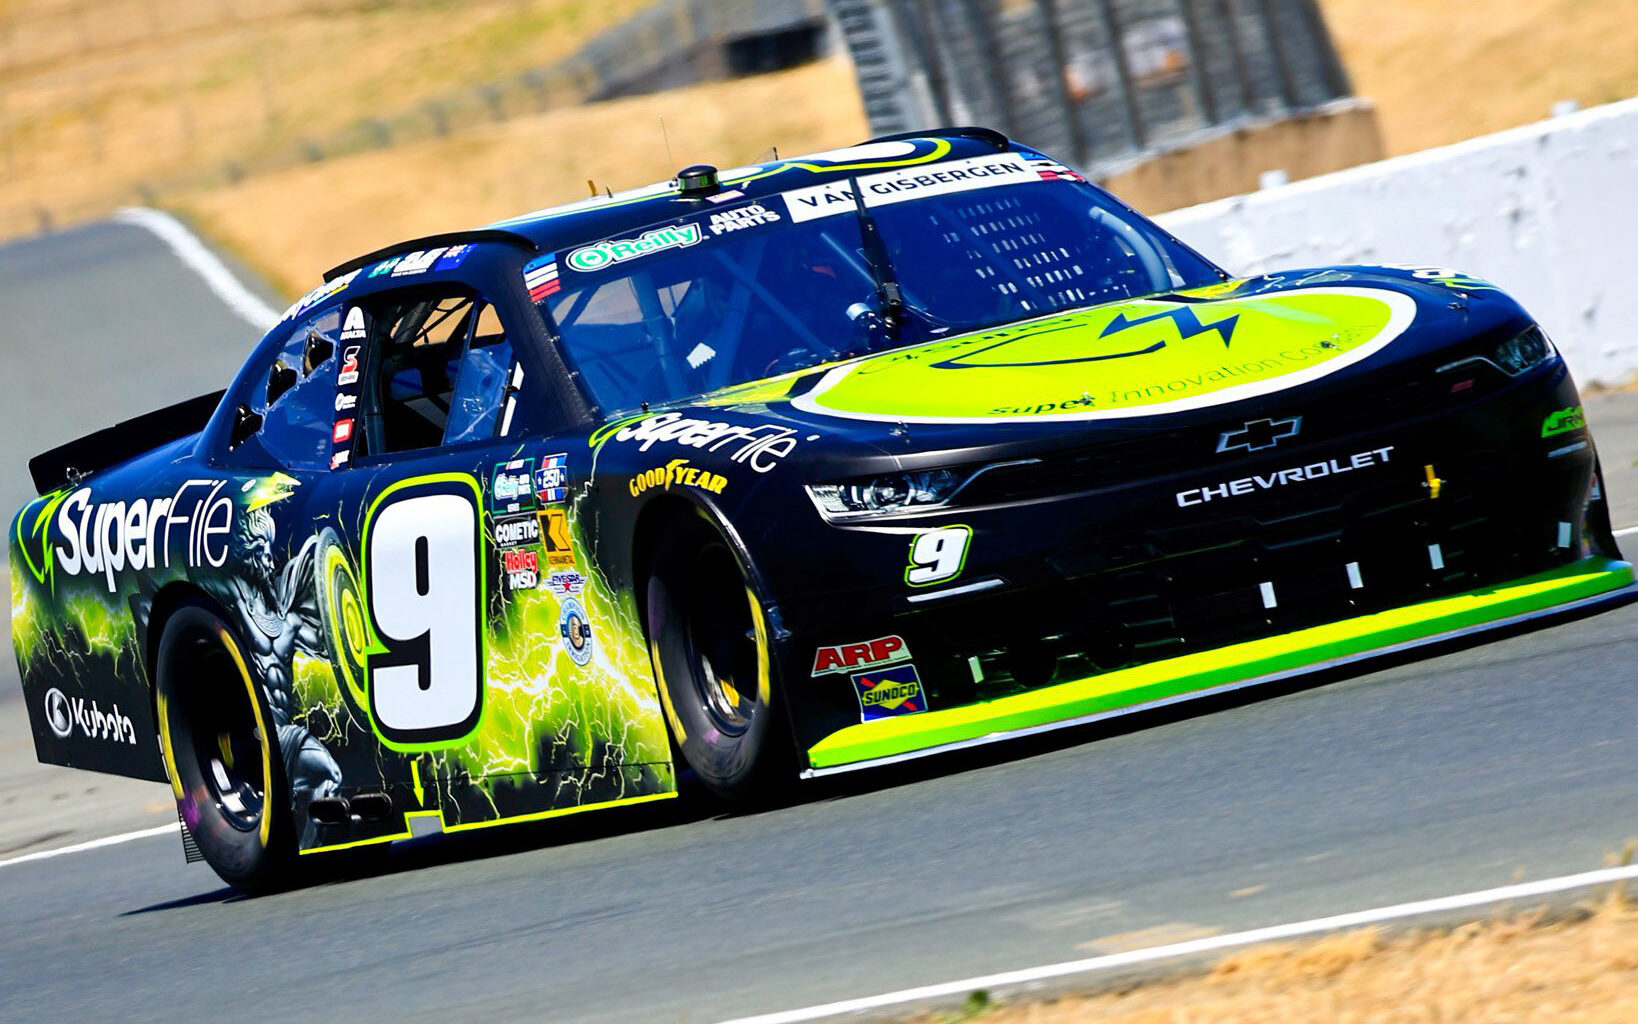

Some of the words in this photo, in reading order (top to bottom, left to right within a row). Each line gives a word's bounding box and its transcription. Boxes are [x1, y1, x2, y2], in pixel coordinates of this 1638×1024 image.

[870, 162, 1024, 195] GISBERGEN
[708, 211, 781, 235] PARTS
[709, 205, 766, 225] AUTO
[574, 229, 694, 268] O'Reilly
[1111, 355, 1281, 403] Innovation
[615, 412, 798, 473] SuperFile
[629, 458, 728, 497] GOODYEAR
[1176, 446, 1394, 507] CHEVROLET
[55, 479, 233, 593] SuperFile
[495, 520, 538, 543] COMETIC
[909, 528, 968, 584] 9
[509, 571, 537, 590] MSD
[371, 494, 477, 730] 9
[815, 637, 903, 671] ARP
[864, 683, 917, 705] SUNOCO
[72, 697, 136, 745] Kubota
